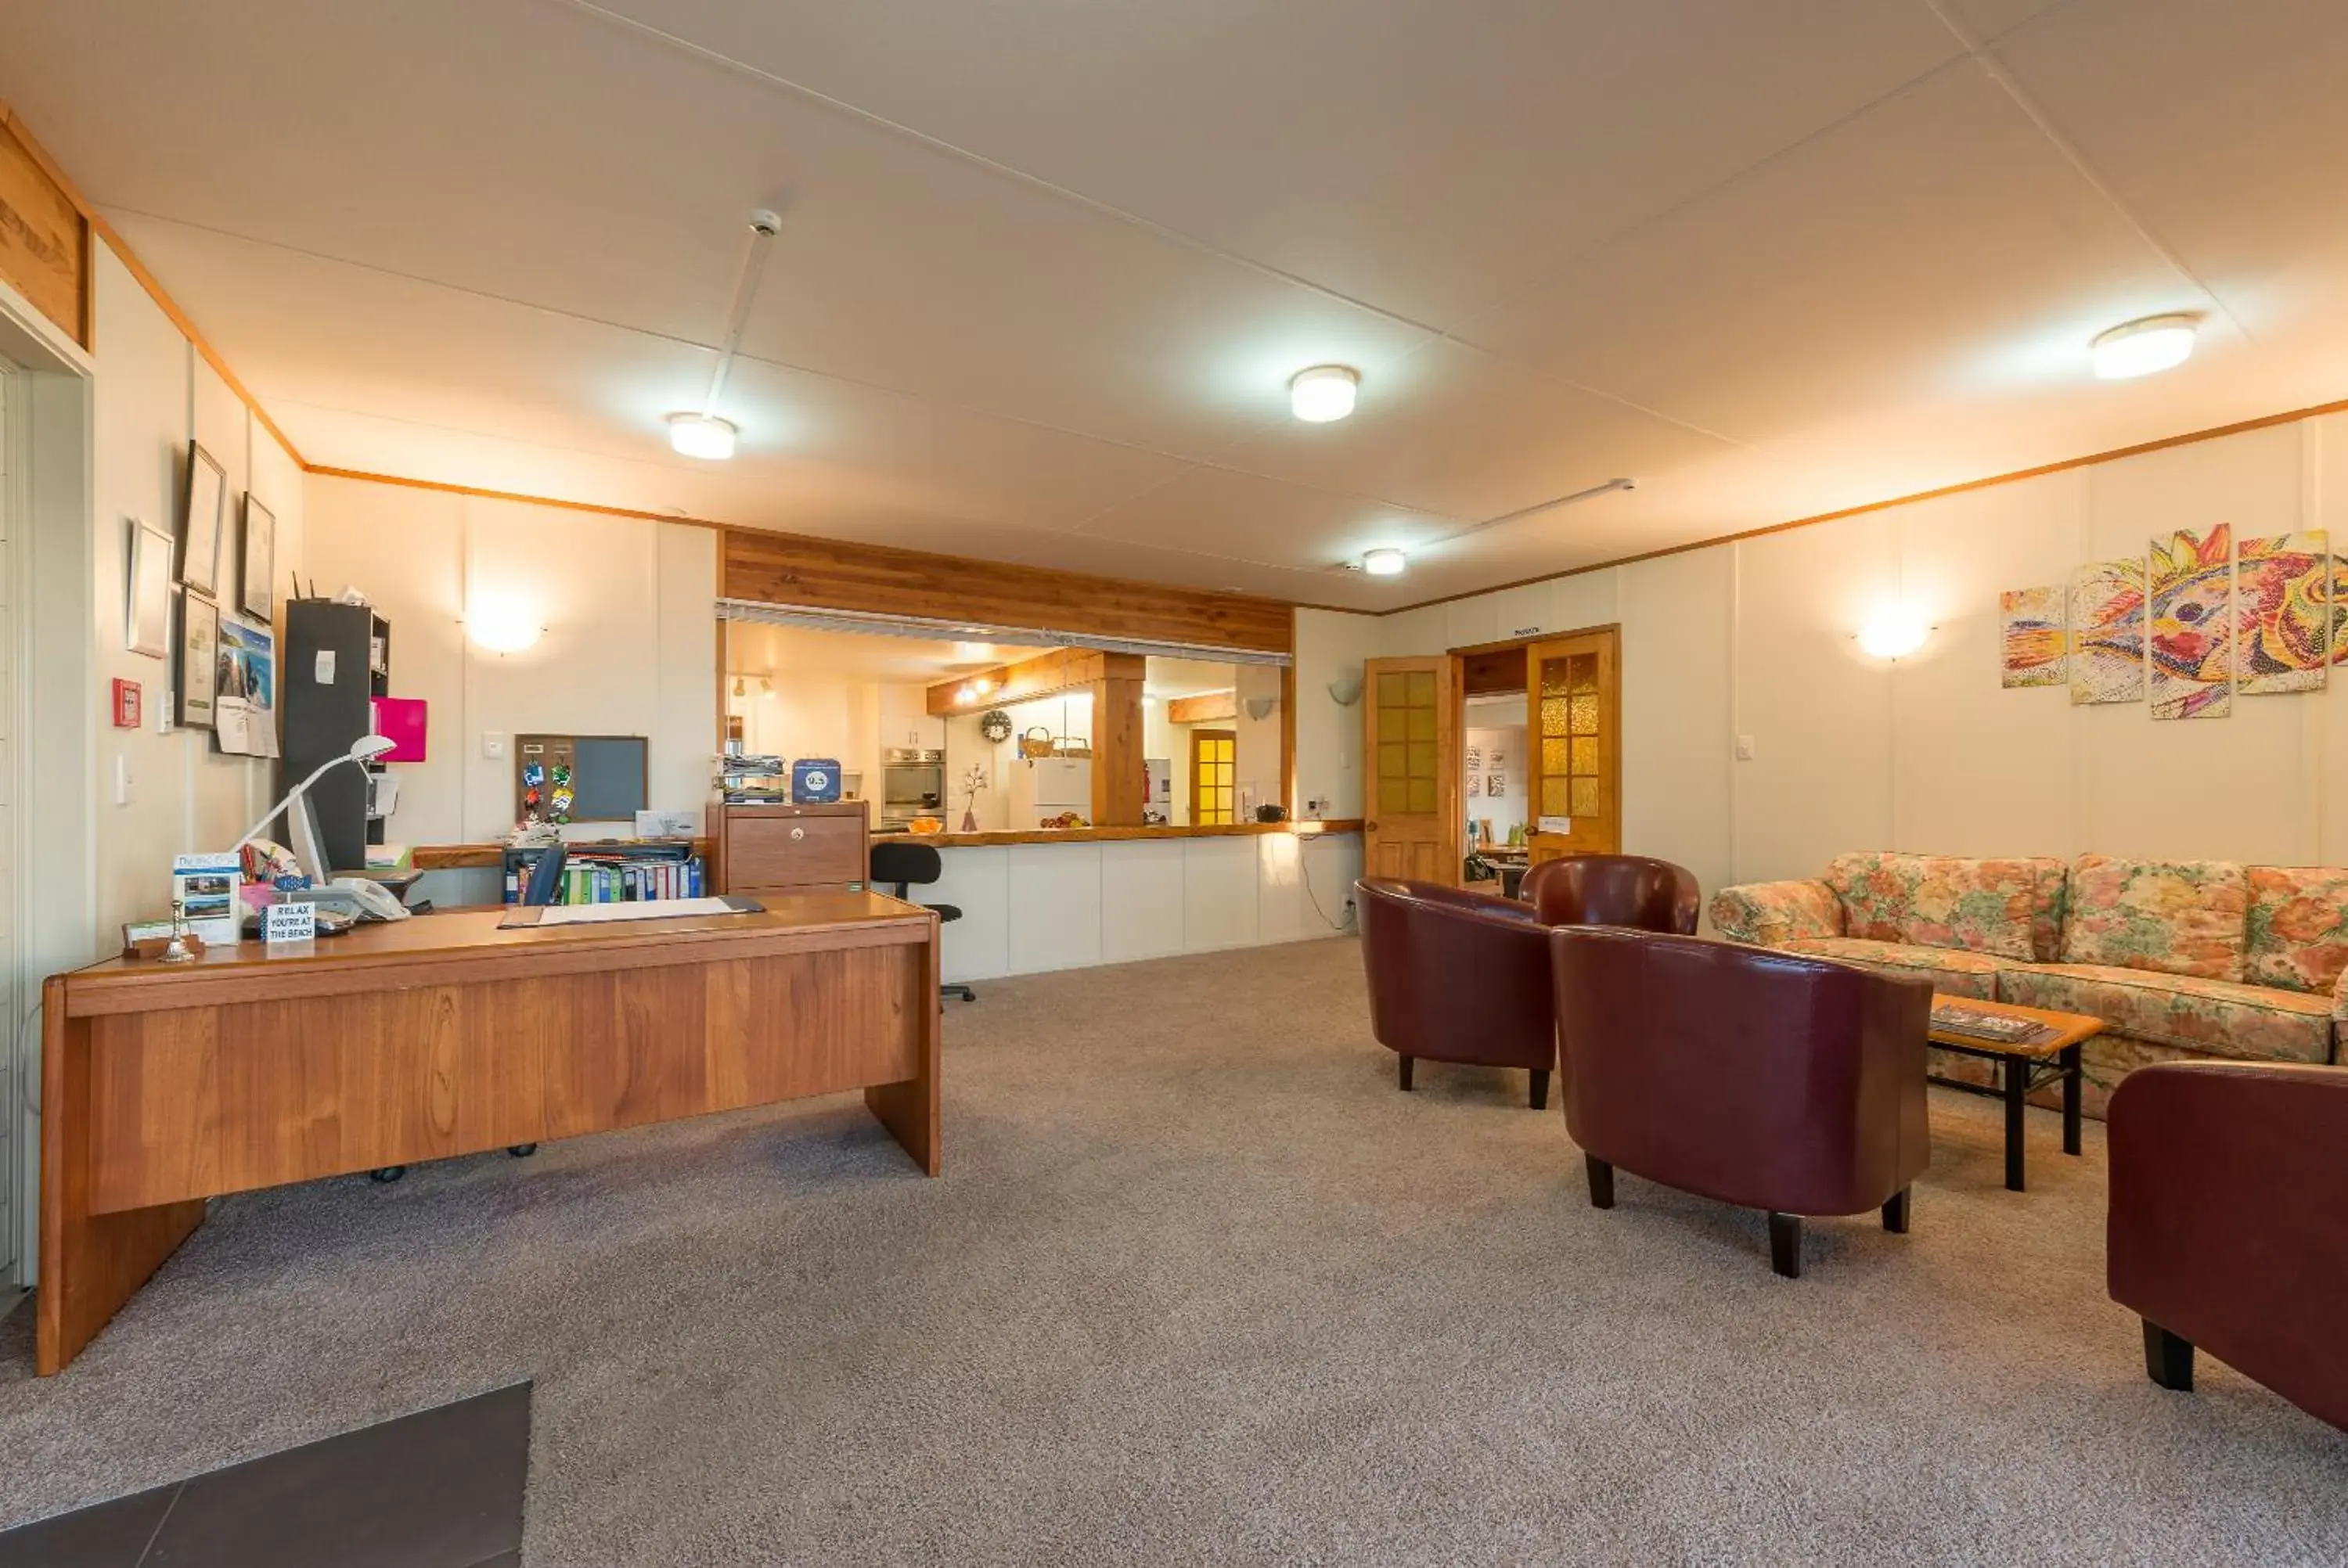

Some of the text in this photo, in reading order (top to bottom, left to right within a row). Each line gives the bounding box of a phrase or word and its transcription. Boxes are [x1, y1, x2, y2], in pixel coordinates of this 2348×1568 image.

[278, 905, 310, 915] RELAX
[271, 916, 312, 927] YOU'RE AT
[270, 927, 312, 939] THE BEACH
